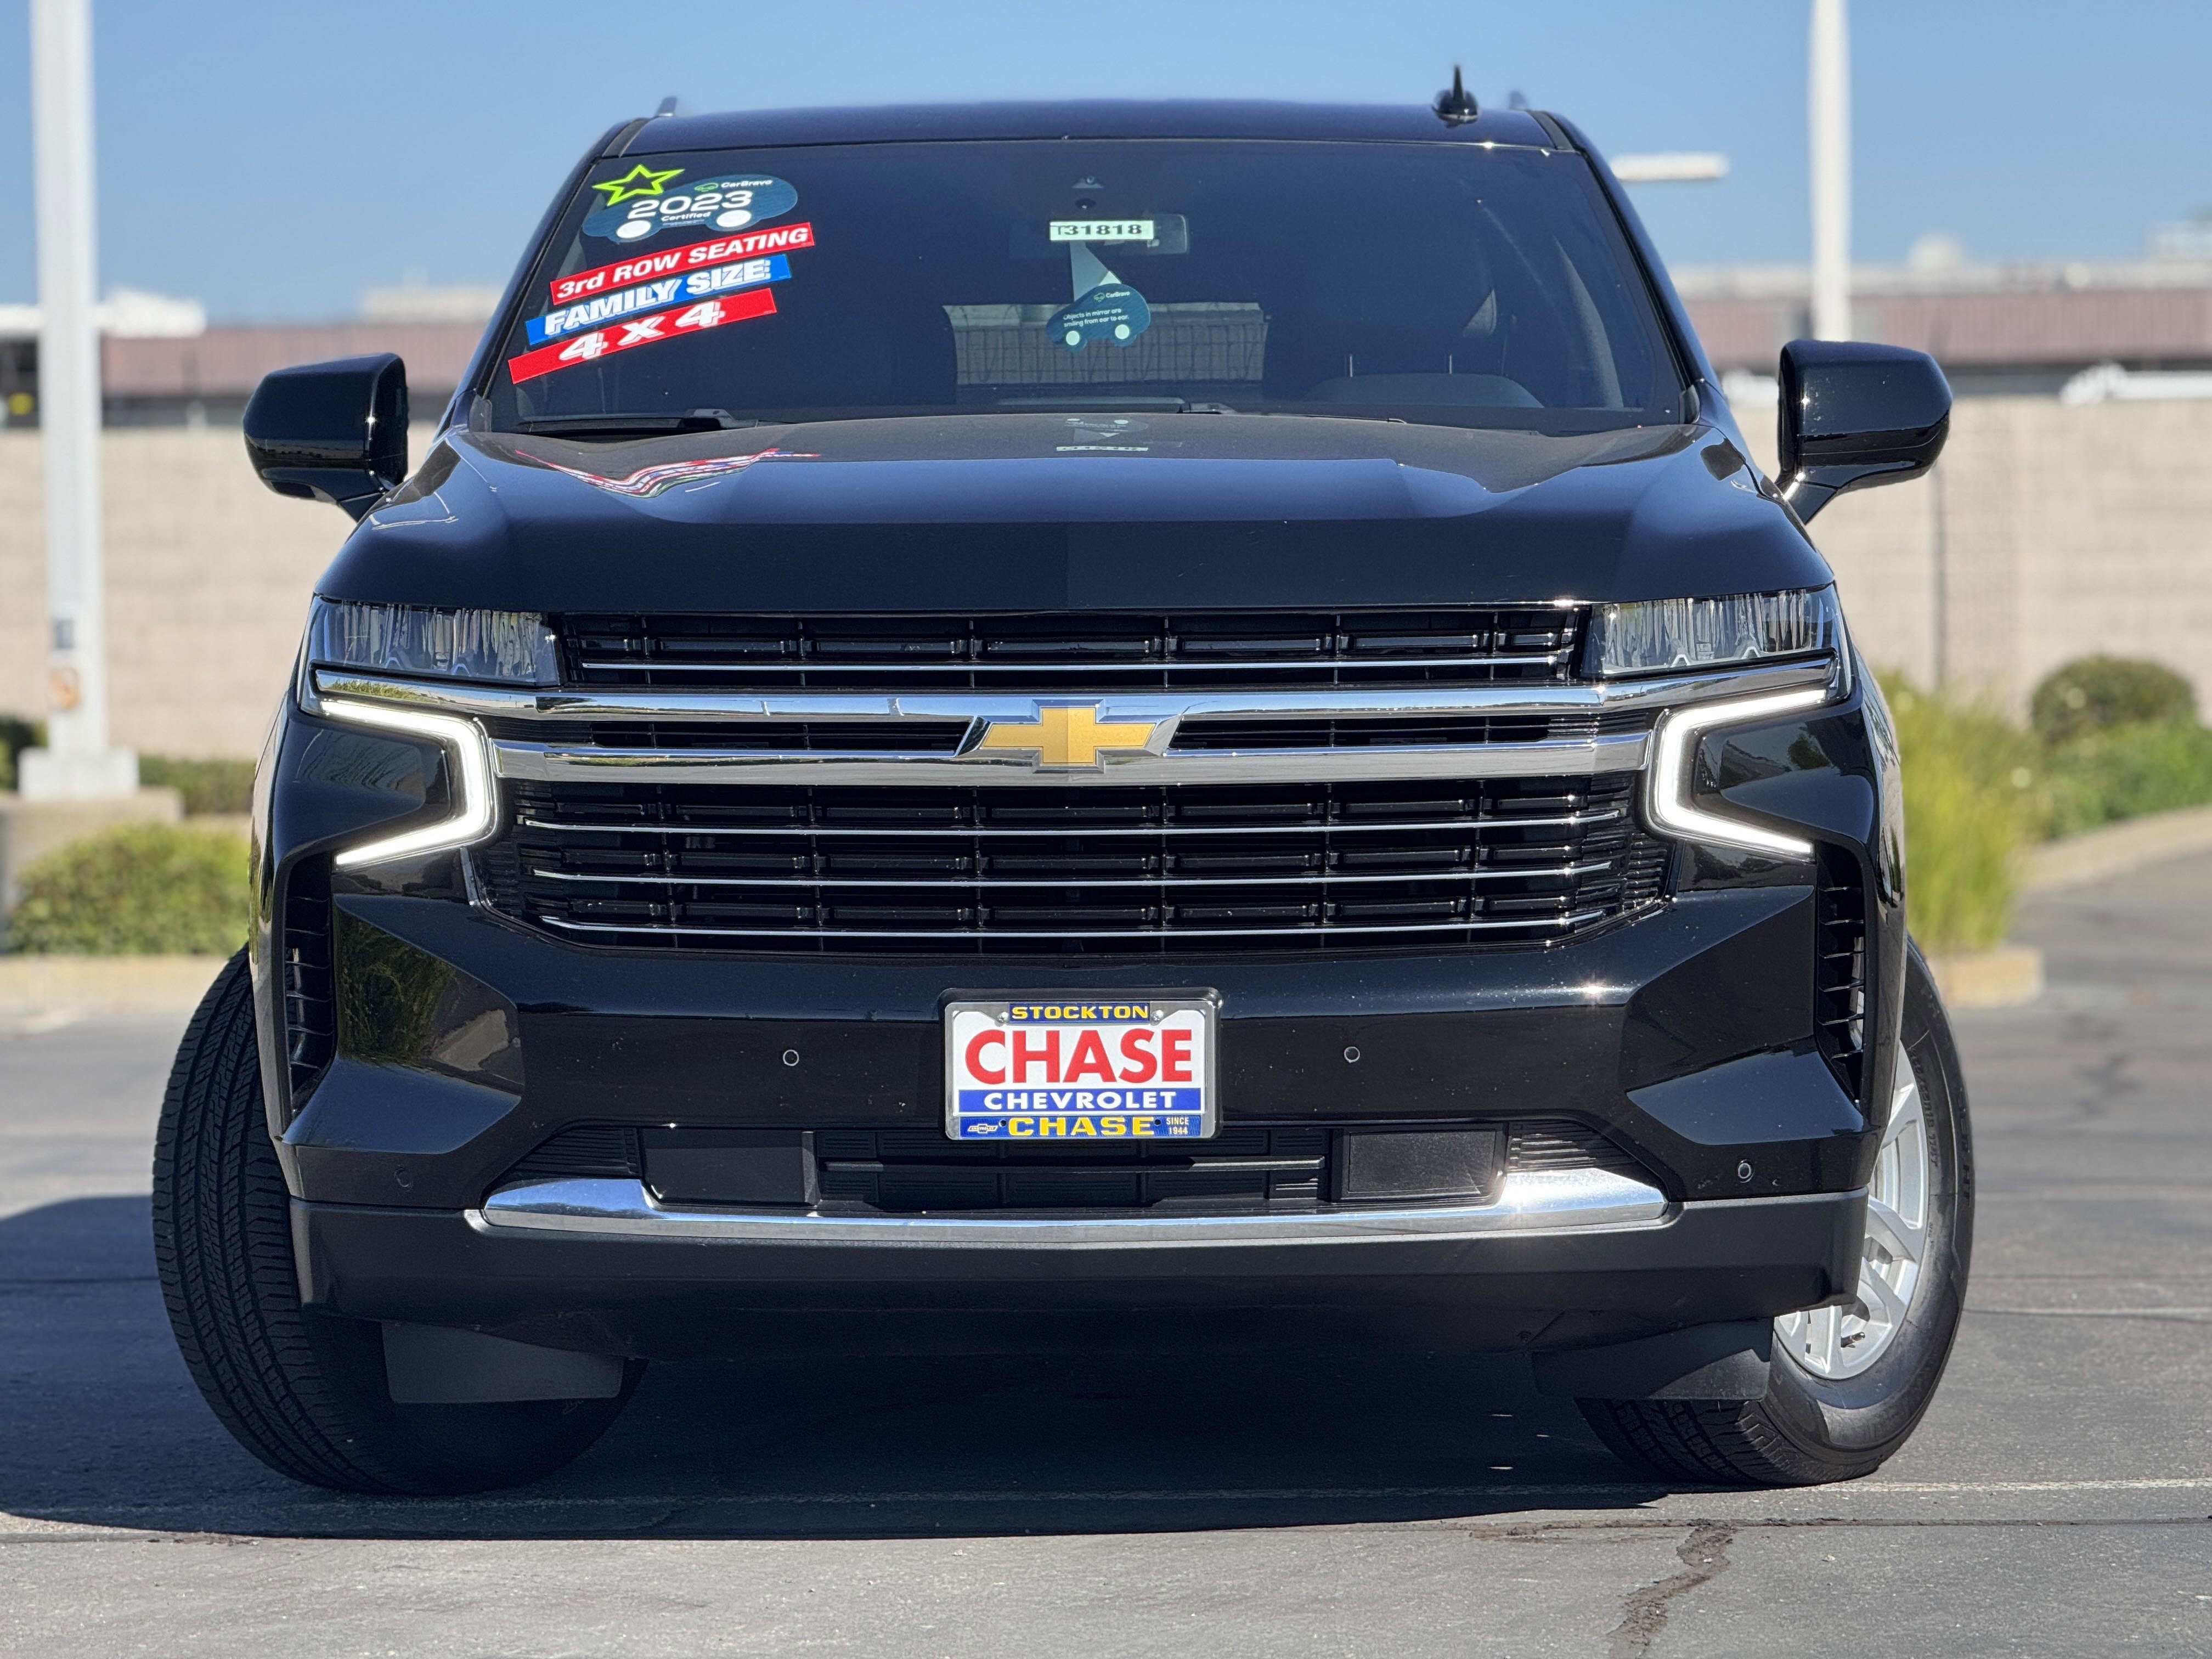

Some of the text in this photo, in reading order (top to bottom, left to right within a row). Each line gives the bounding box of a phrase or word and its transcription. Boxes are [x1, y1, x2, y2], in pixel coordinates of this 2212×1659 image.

[721, 179, 773, 189] CarBravo
[627, 190, 754, 219] 2023
[661, 212, 712, 222] Certified
[557, 227, 810, 299] 3rd ROW SEATING
[544, 258, 771, 337] FAMILY SIZE
[559, 331, 608, 362] 4
[675, 301, 726, 329] 4
[1012, 1006, 1148, 1020] STOCKTON
[965, 1029, 1193, 1085] CHASE
[984, 1091, 1177, 1110] CHEVROLET
[1008, 1117, 1155, 1136] CHASE
[1166, 1117, 1189, 1125] SINCE
